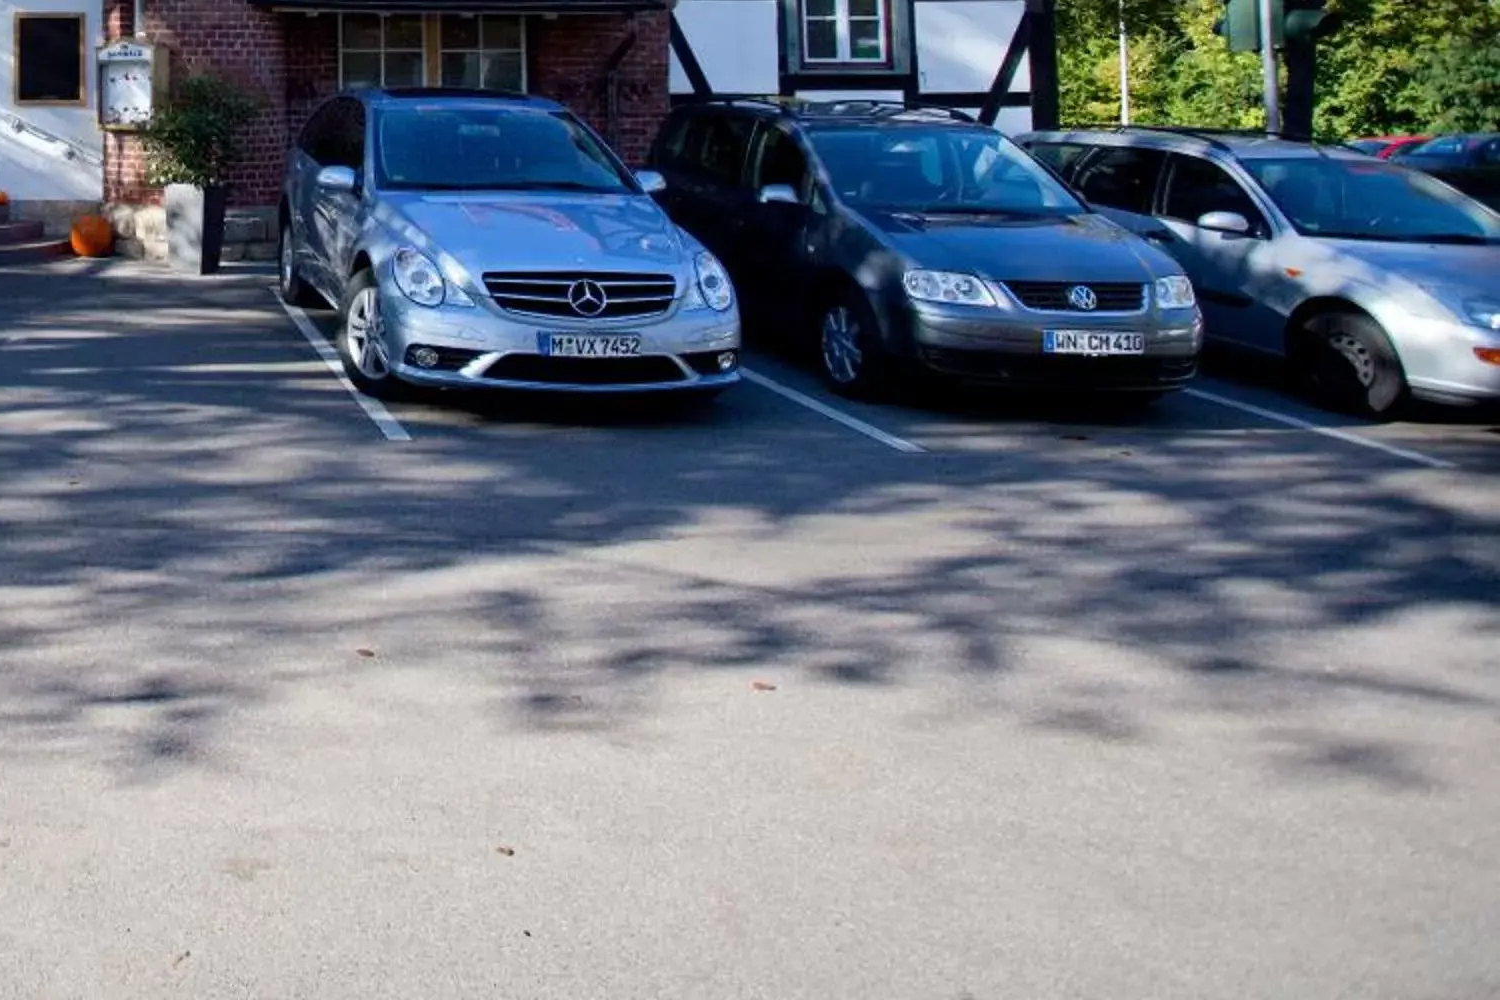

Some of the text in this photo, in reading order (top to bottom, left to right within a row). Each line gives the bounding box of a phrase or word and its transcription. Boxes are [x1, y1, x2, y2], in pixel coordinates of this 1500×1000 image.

[551, 337, 641, 355] M VX 7452
